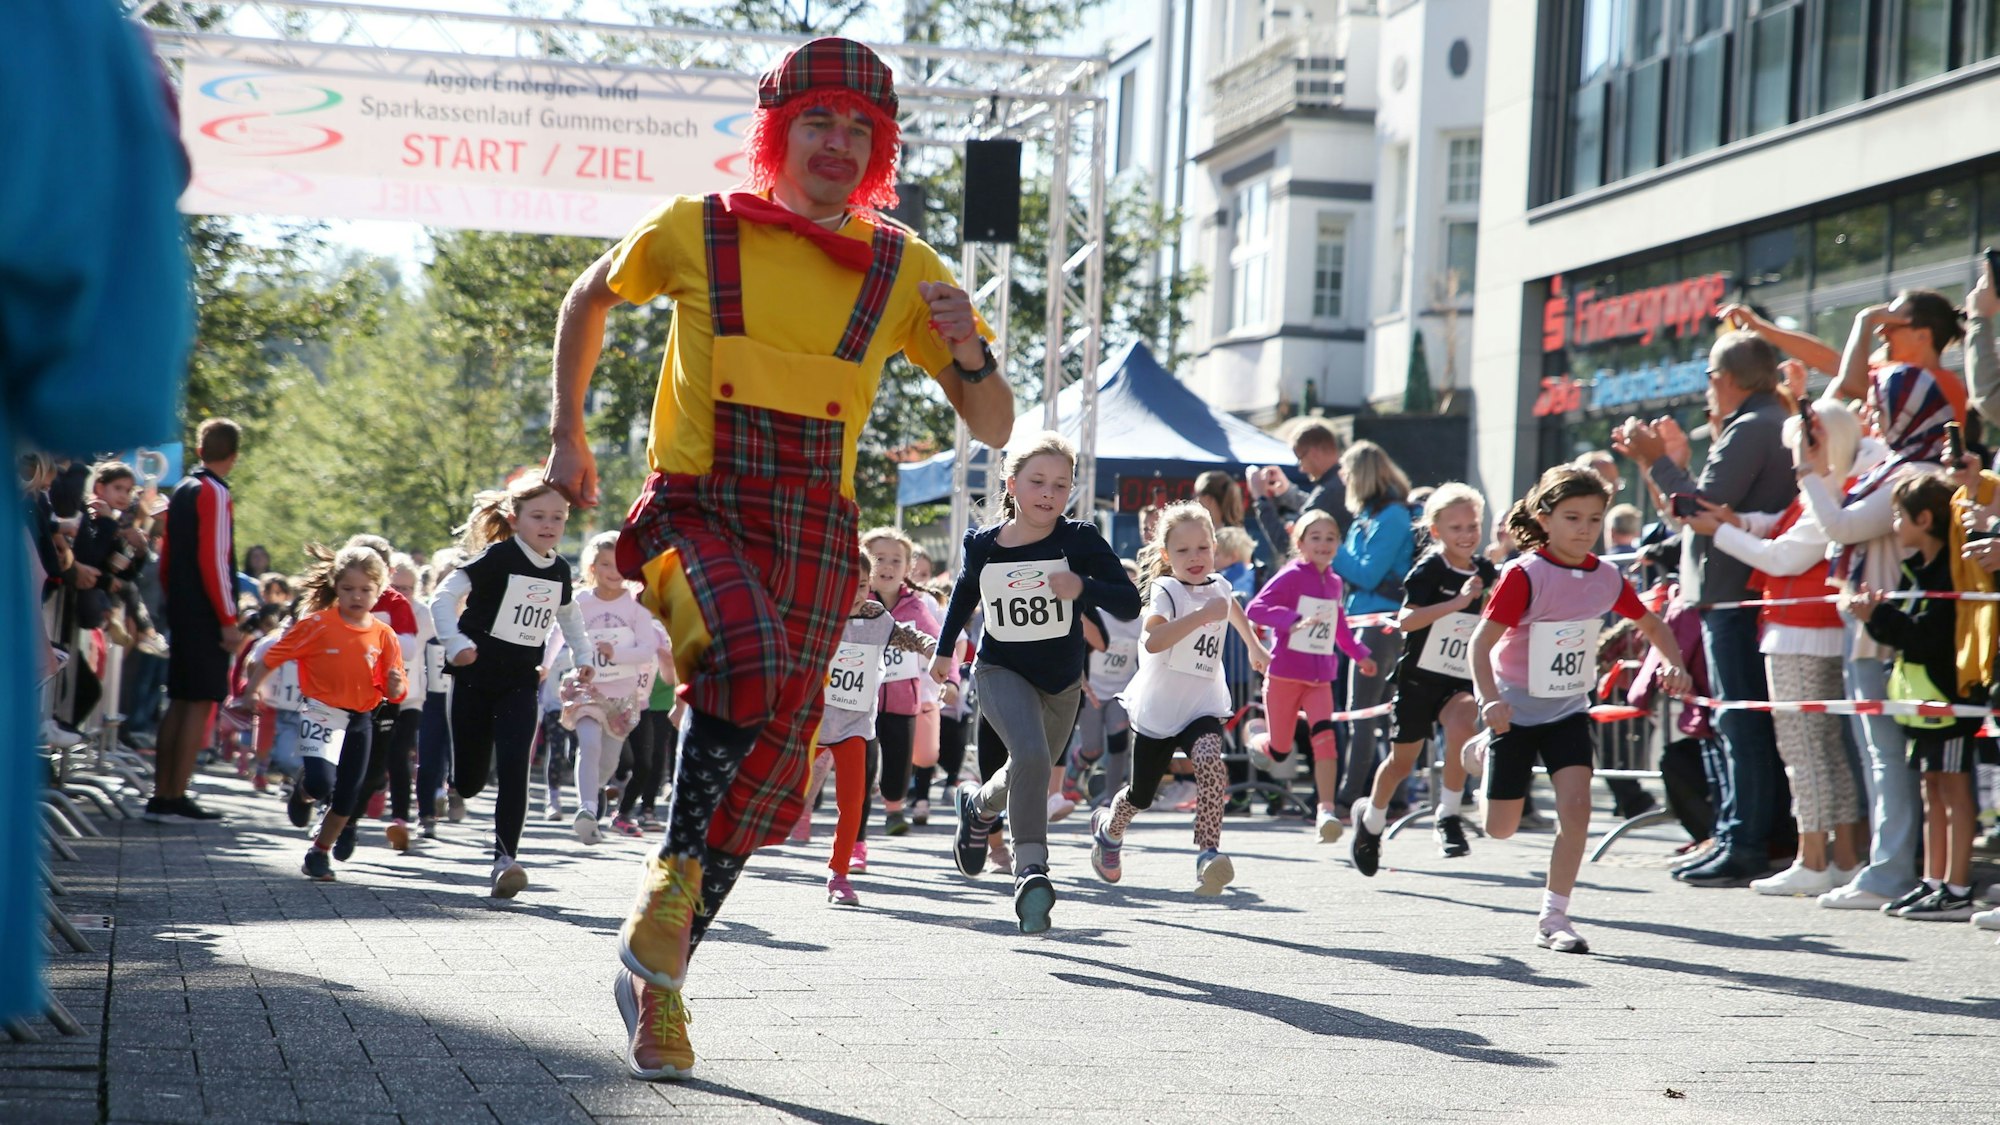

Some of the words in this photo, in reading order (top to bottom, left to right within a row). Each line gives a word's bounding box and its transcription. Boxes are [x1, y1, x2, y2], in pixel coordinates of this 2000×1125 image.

[425, 69, 588, 98] AggerEnergie-
[597, 83, 639, 102] und
[360, 97, 532, 127] Sparkassenlauf
[540, 108, 699, 139] Gummersbach
[401, 132, 528, 174] START
[541, 142, 563, 177] /
[575, 144, 655, 183] ZIEL
[1573, 271, 1726, 347] Finanzgruppe
[513, 603, 552, 630] 1018
[991, 596, 1064, 627] 1681
[518, 632, 536, 641] Fiona
[1193, 633, 1220, 659] 464
[1103, 652, 1128, 668] 709
[1550, 650, 1586, 677] 487
[829, 667, 864, 693] 504
[1548, 683, 1566, 692] Ana
[831, 694, 858, 706] Sainab
[300, 719, 334, 744] 028
